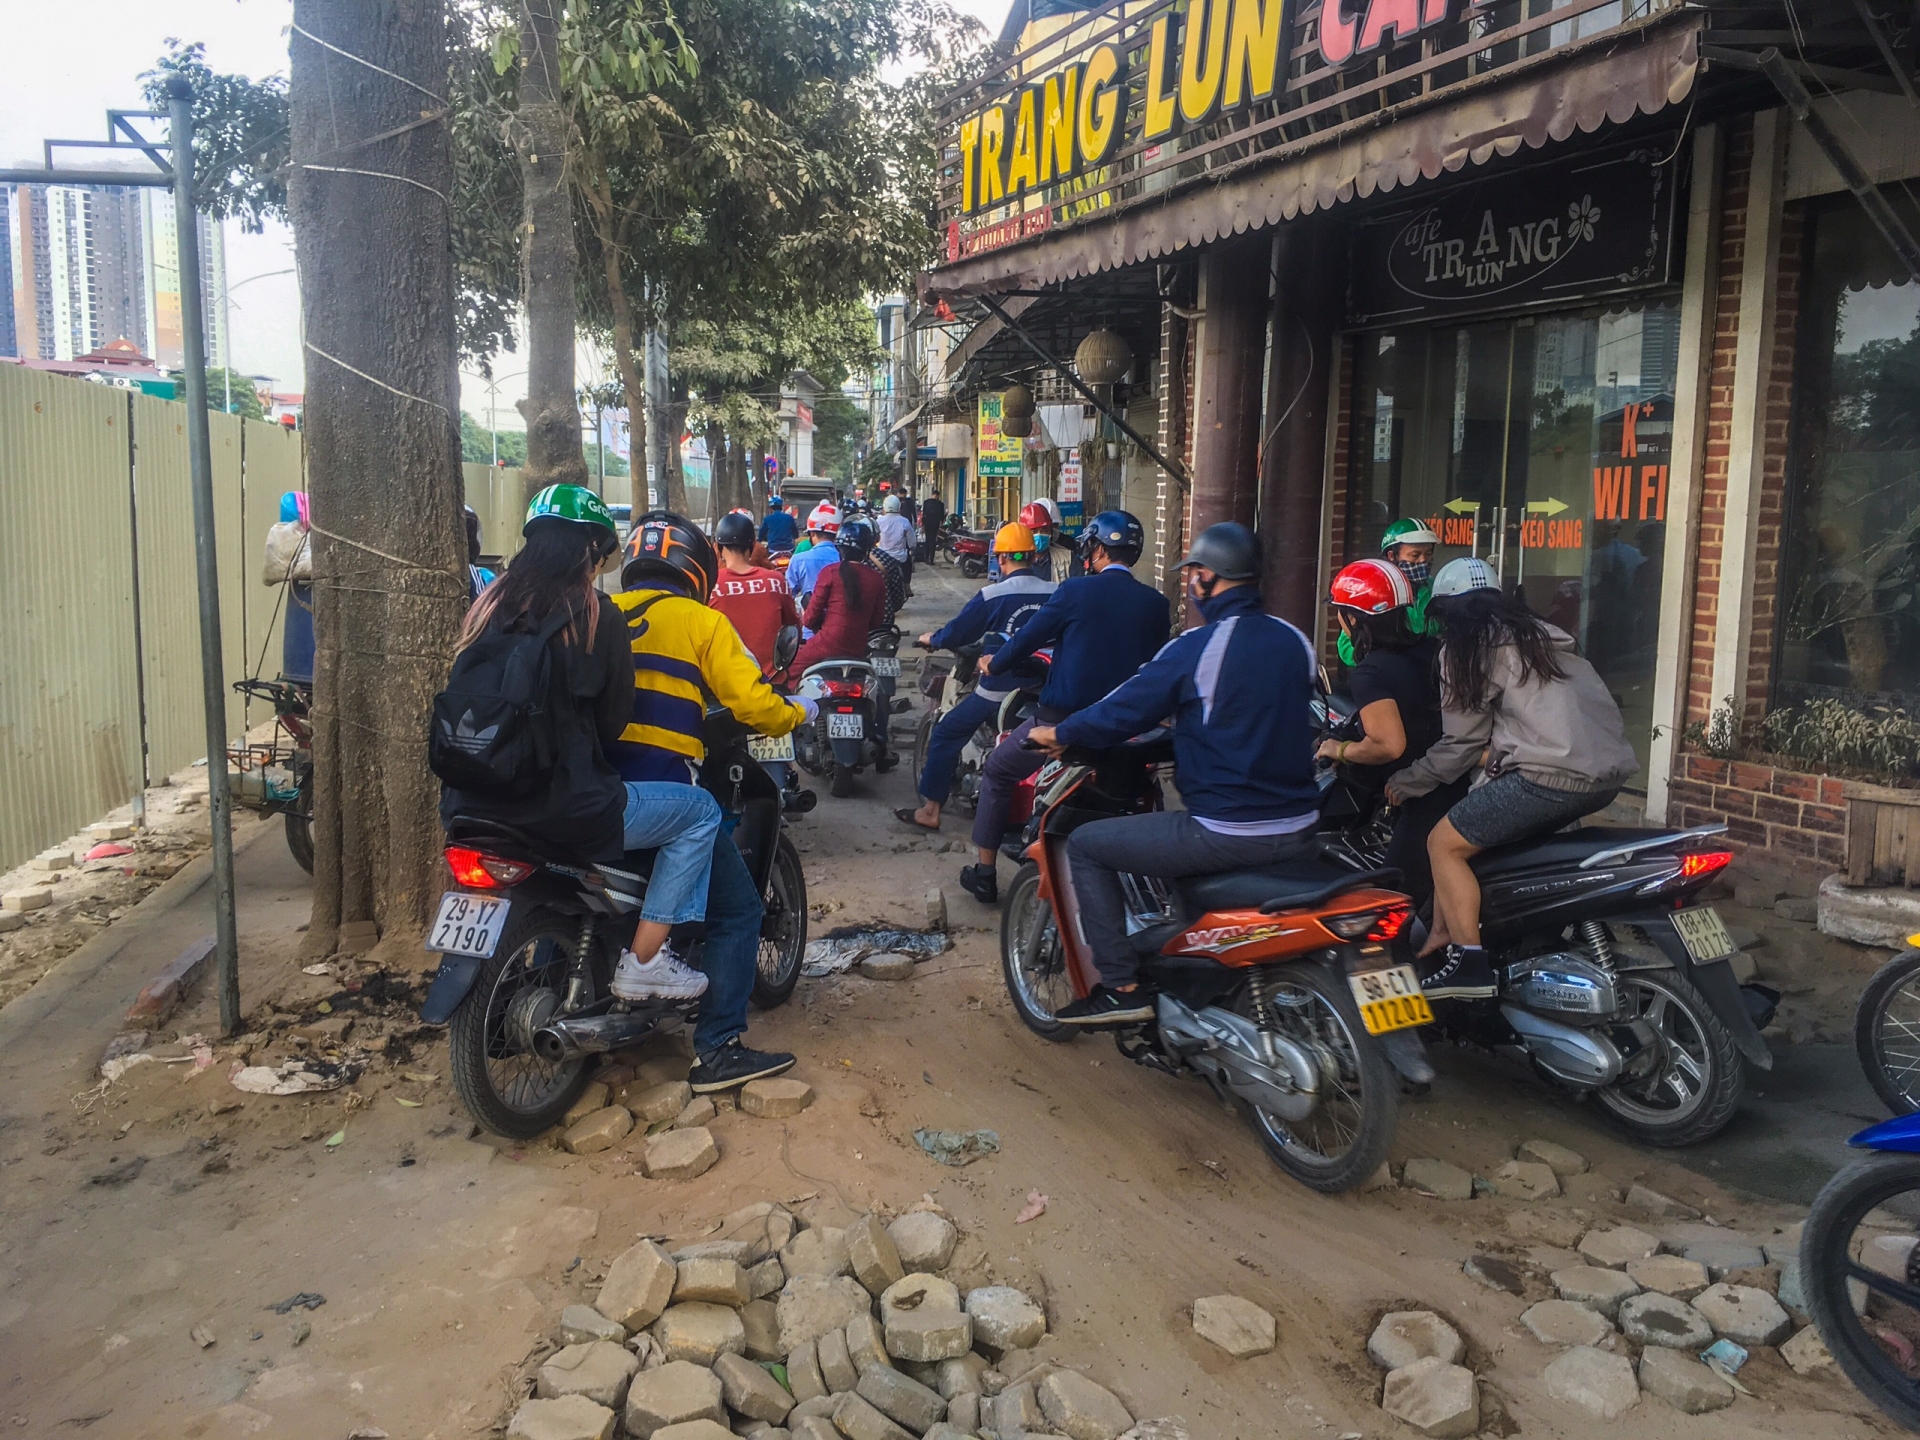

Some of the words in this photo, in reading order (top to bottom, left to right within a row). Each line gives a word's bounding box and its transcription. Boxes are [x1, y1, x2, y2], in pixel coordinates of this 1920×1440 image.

[960, 44, 1122, 214] TRANG
[1422, 209, 1561, 283] TRANG
[1593, 466, 1632, 520] WI
[1639, 465, 1668, 520] FI
[1445, 518, 1474, 546] SANG
[1521, 513, 1545, 548] KÉO
[1547, 518, 1583, 549] SANG
[830, 726, 862, 738] 421.52
[752, 747, 792, 760] 922.40
[435, 923, 489, 952] 2190
[1536, 987, 1589, 1001] HONDA
